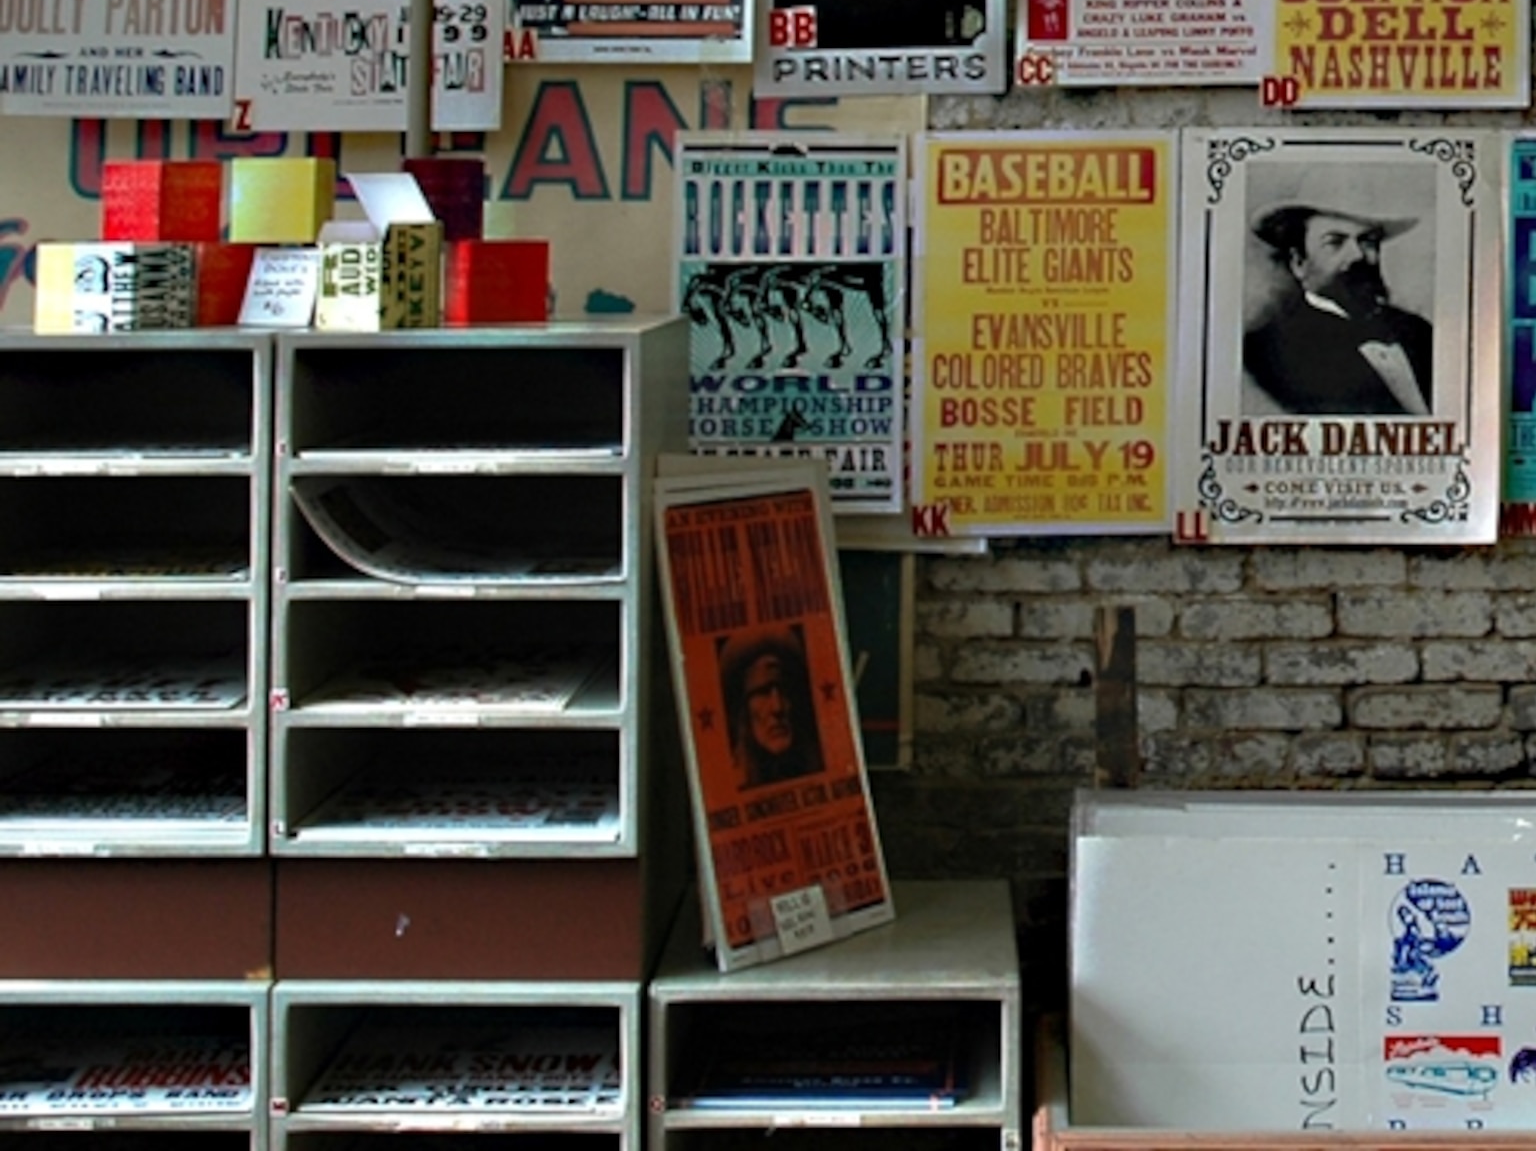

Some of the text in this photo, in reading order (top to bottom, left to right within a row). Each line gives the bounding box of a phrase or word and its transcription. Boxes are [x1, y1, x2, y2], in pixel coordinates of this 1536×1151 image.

[769, 10, 815, 46] BB
[1321, 6, 1475, 41] DELL
[773, 53, 987, 82] PRINTERS
[1291, 45, 1500, 90] NASHVILLE
[943, 151, 1150, 200] BASEBALL
[980, 208, 1118, 245] BALTIMORE
[962, 248, 1134, 284] ELITE GIANTS
[688, 375, 892, 392] WORLD
[940, 397, 1143, 427] BOSSE FIELD
[1209, 420, 1463, 457] JACK DANIEL
[826, 450, 885, 472] FAIR
[1265, 480, 1373, 495] COME VISIT
